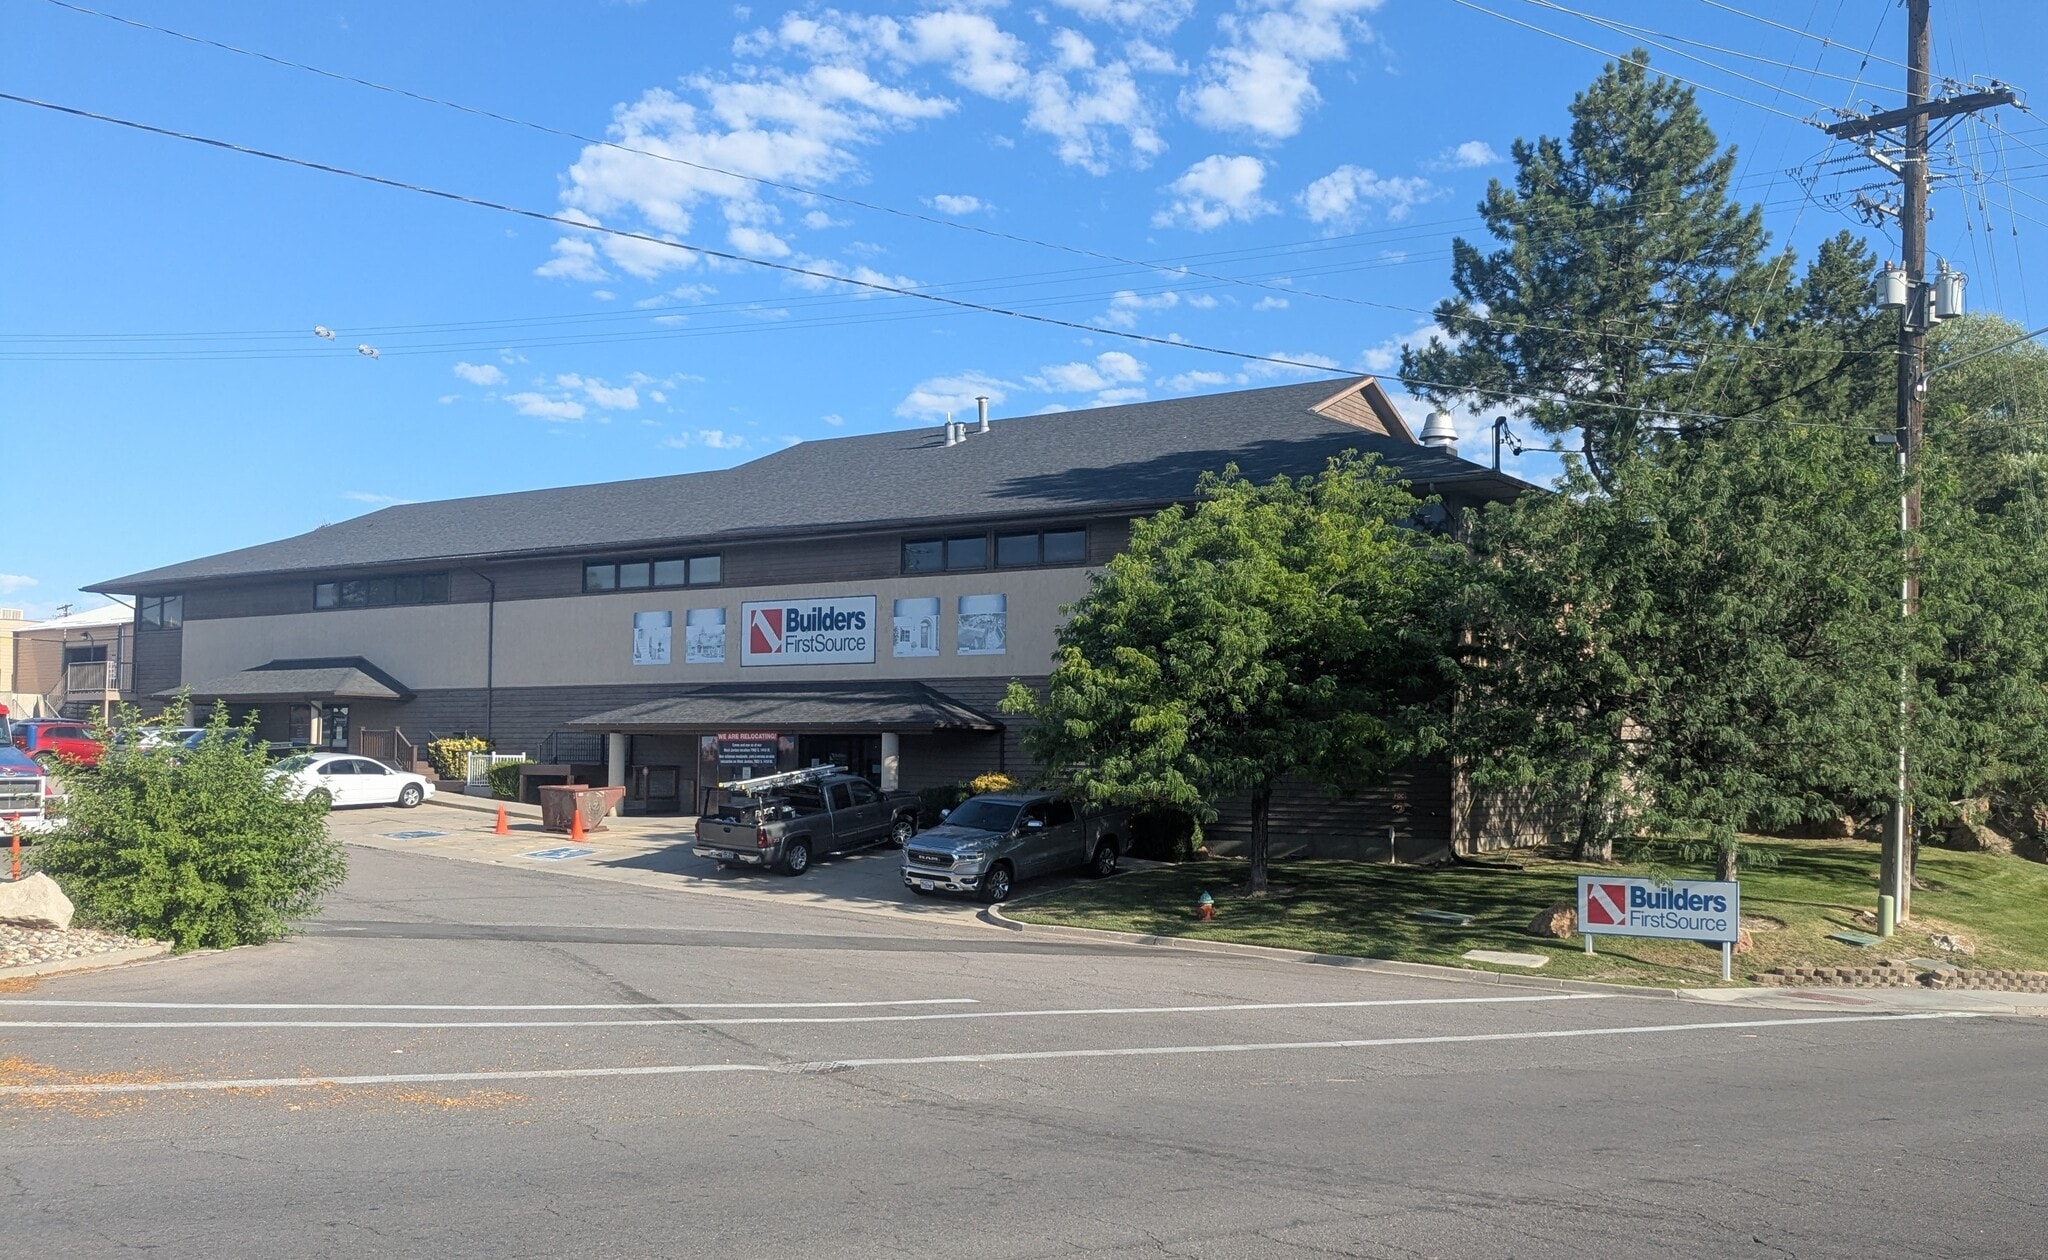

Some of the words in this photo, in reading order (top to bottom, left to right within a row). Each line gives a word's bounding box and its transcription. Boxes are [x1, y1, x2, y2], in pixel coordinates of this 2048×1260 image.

[786, 606, 866, 632] Builders
[786, 634, 865, 652] FirstSource
[1630, 885, 1727, 913] Builders
[1630, 910, 1727, 932] FirstSource
